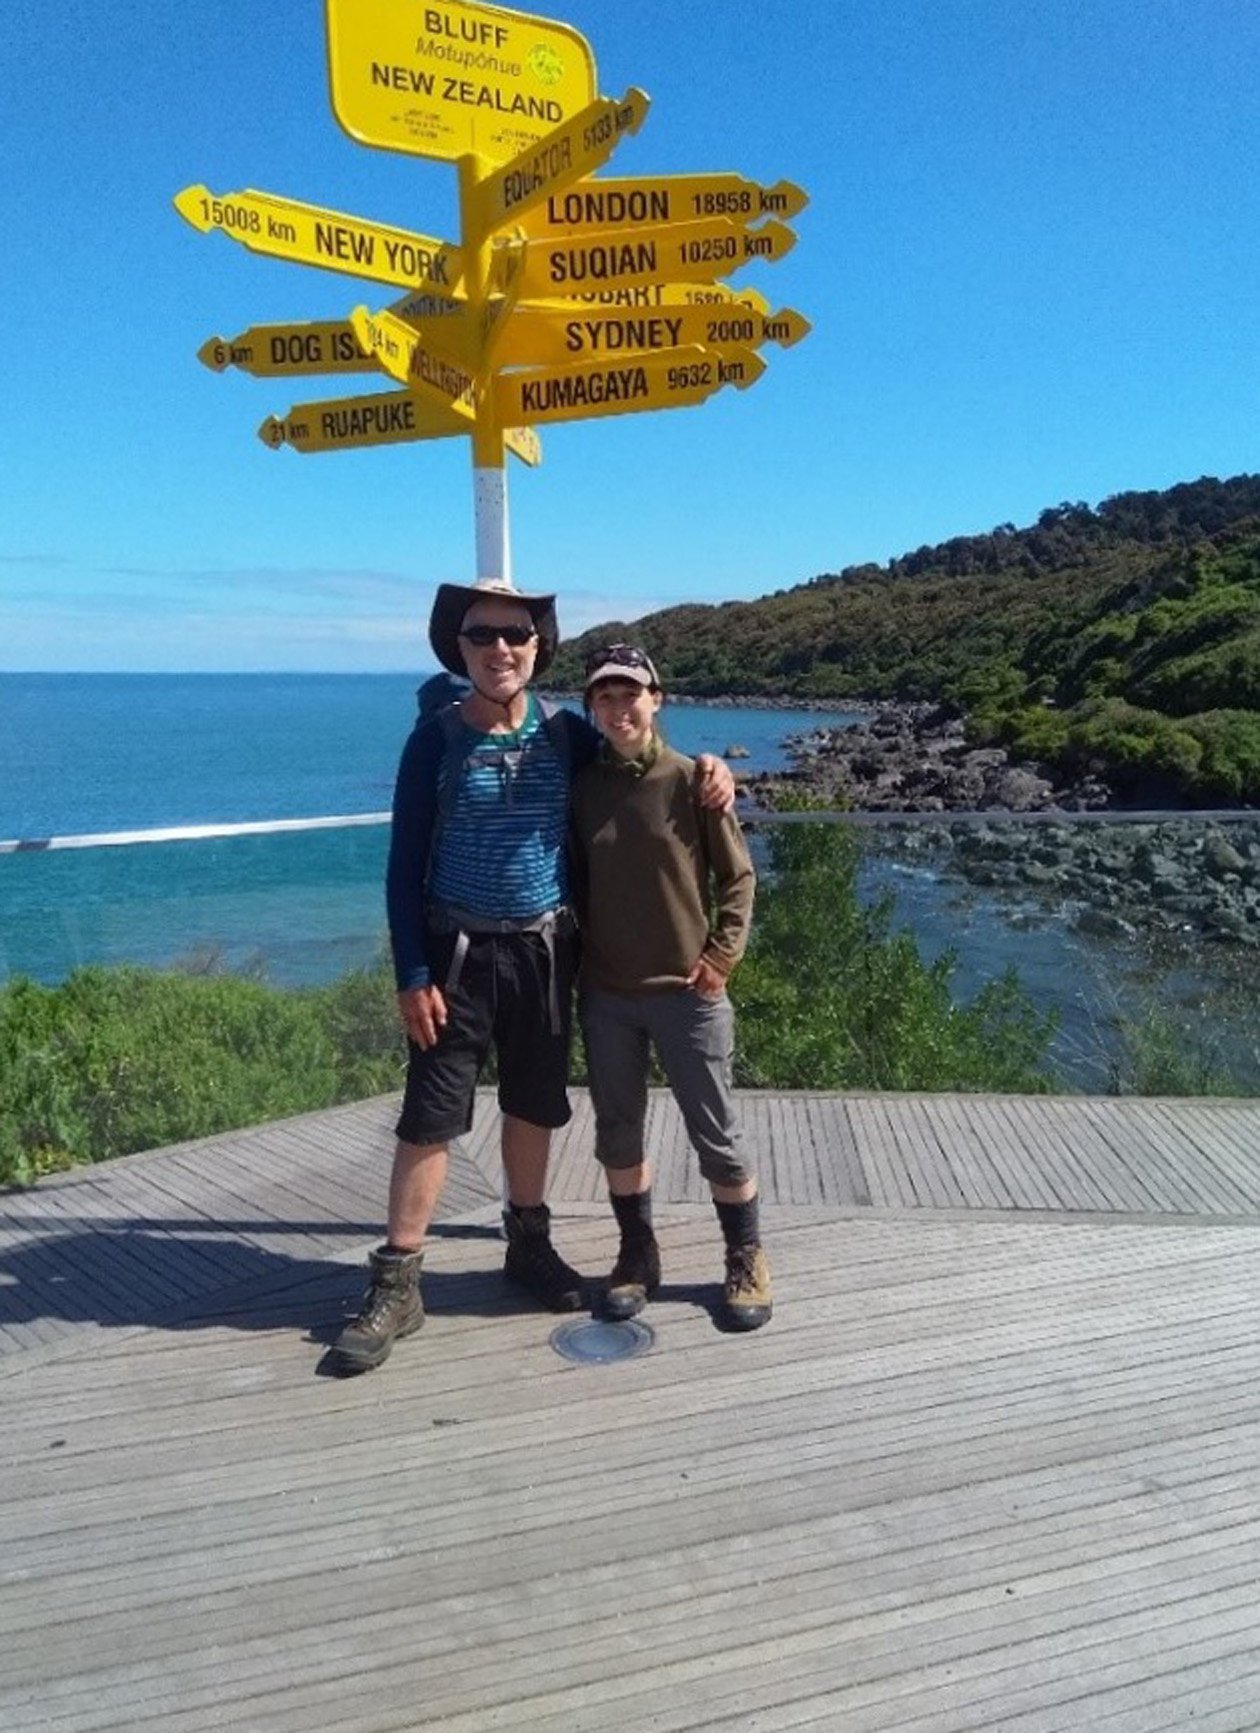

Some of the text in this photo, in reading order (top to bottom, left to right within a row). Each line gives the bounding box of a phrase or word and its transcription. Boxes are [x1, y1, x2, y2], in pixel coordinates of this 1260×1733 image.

[425, 9, 509, 48] BLUFF
[371, 62, 564, 123] NEW ZEALAND
[504, 136, 572, 208] EQUATOR
[583, 113, 612, 152] 5133
[548, 190, 787, 224] LONDON 18958 km
[200, 198, 449, 286] 15008 km NEW YORK
[550, 234, 772, 283] SUQIAN 10250 km
[566, 284, 664, 308] OBART
[214, 345, 226, 365] 6
[229, 342, 254, 364] km
[270, 333, 322, 365] DOG
[331, 331, 378, 361] ISL
[566, 317, 790, 351] SYDNEY 2000 km
[521, 360, 744, 412] KUMAGAYA 9632 km
[270, 401, 416, 443] 21 km RUAPUKE
